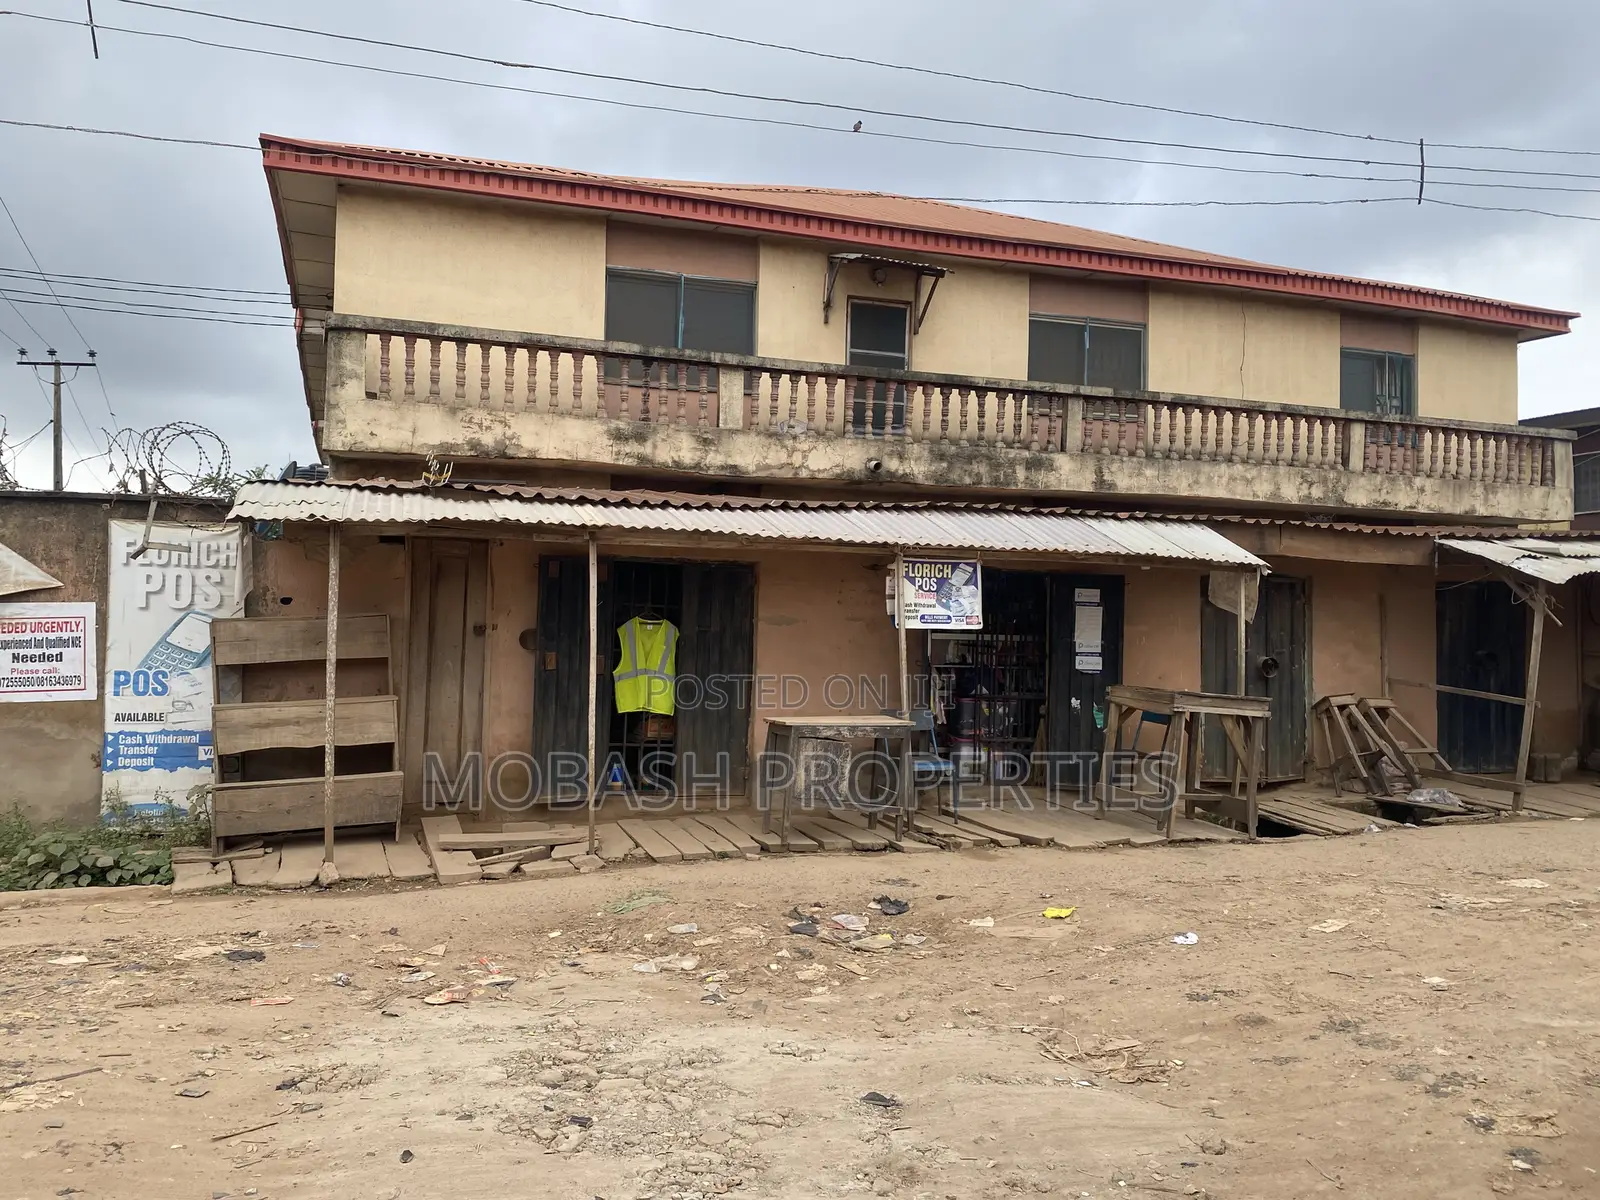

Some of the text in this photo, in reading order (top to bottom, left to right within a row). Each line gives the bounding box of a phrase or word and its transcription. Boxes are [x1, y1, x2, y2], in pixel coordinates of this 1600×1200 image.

[903, 563, 952, 578] FLORICH
[138, 567, 223, 610] POS
[915, 577, 937, 591] POS
[914, 592, 937, 600] SERVICE
[0, 621, 83, 634] EDED URGENTLY.
[33, 637, 44, 649] And
[45, 636, 70, 650] Qualified
[71, 635, 82, 648] NCE
[11, 652, 63, 663] Needed
[10, 666, 61, 675] Please call:
[0, 675, 82, 688] 72555050/08163436979
[113, 670, 169, 696] POS
[114, 712, 165, 722] AVAILABLE
[118, 733, 200, 745] Cash Withdrawal
[118, 745, 159, 755] Transfer
[117, 756, 155, 768] Deposit
